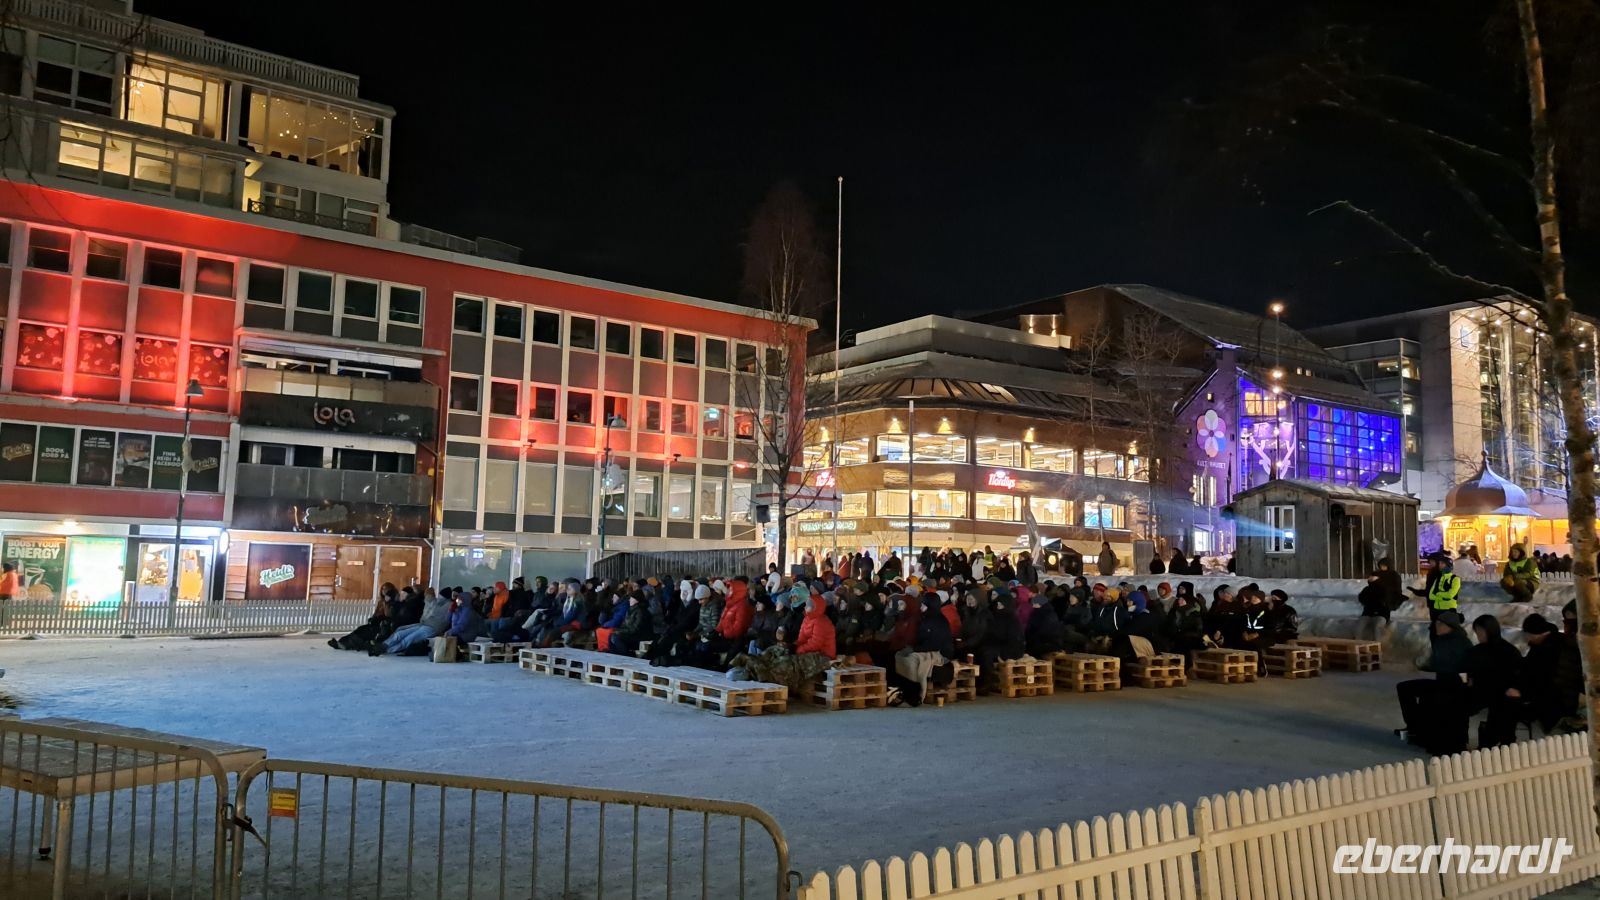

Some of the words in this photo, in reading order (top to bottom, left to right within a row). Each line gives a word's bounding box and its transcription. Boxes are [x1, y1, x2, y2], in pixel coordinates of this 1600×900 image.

[8, 539, 37, 547] BOOST
[37, 540, 60, 548] YOUR
[7, 547, 60, 559] ENERGY
